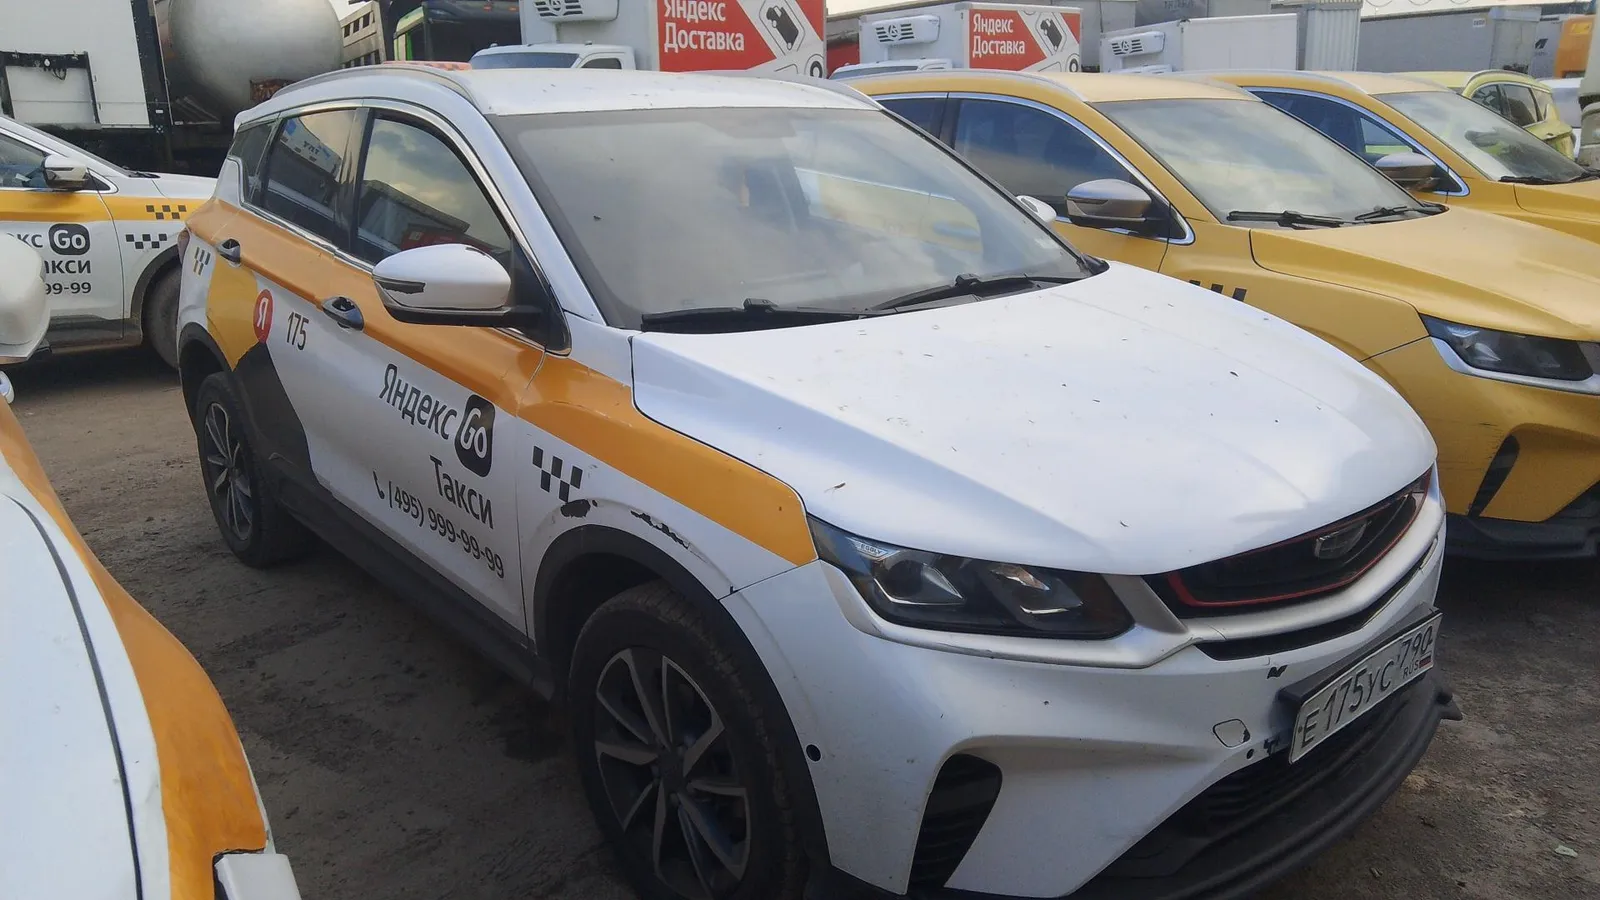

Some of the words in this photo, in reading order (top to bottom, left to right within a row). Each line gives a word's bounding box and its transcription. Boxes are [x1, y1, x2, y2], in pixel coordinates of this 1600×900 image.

[664, 0, 727, 23] Яндекс
[973, 13, 1014, 36] Яндекс
[664, 21, 745, 53] Доставка
[972, 35, 1026, 58] Доставка
[53, 229, 87, 250] Go
[286, 311, 309, 351] 175
[379, 363, 458, 440] Яндекс
[460, 407, 488, 459] Go
[430, 455, 494, 530] Такси
[388, 481, 424, 527] (495)
[428, 508, 505, 579] 999-99-99
